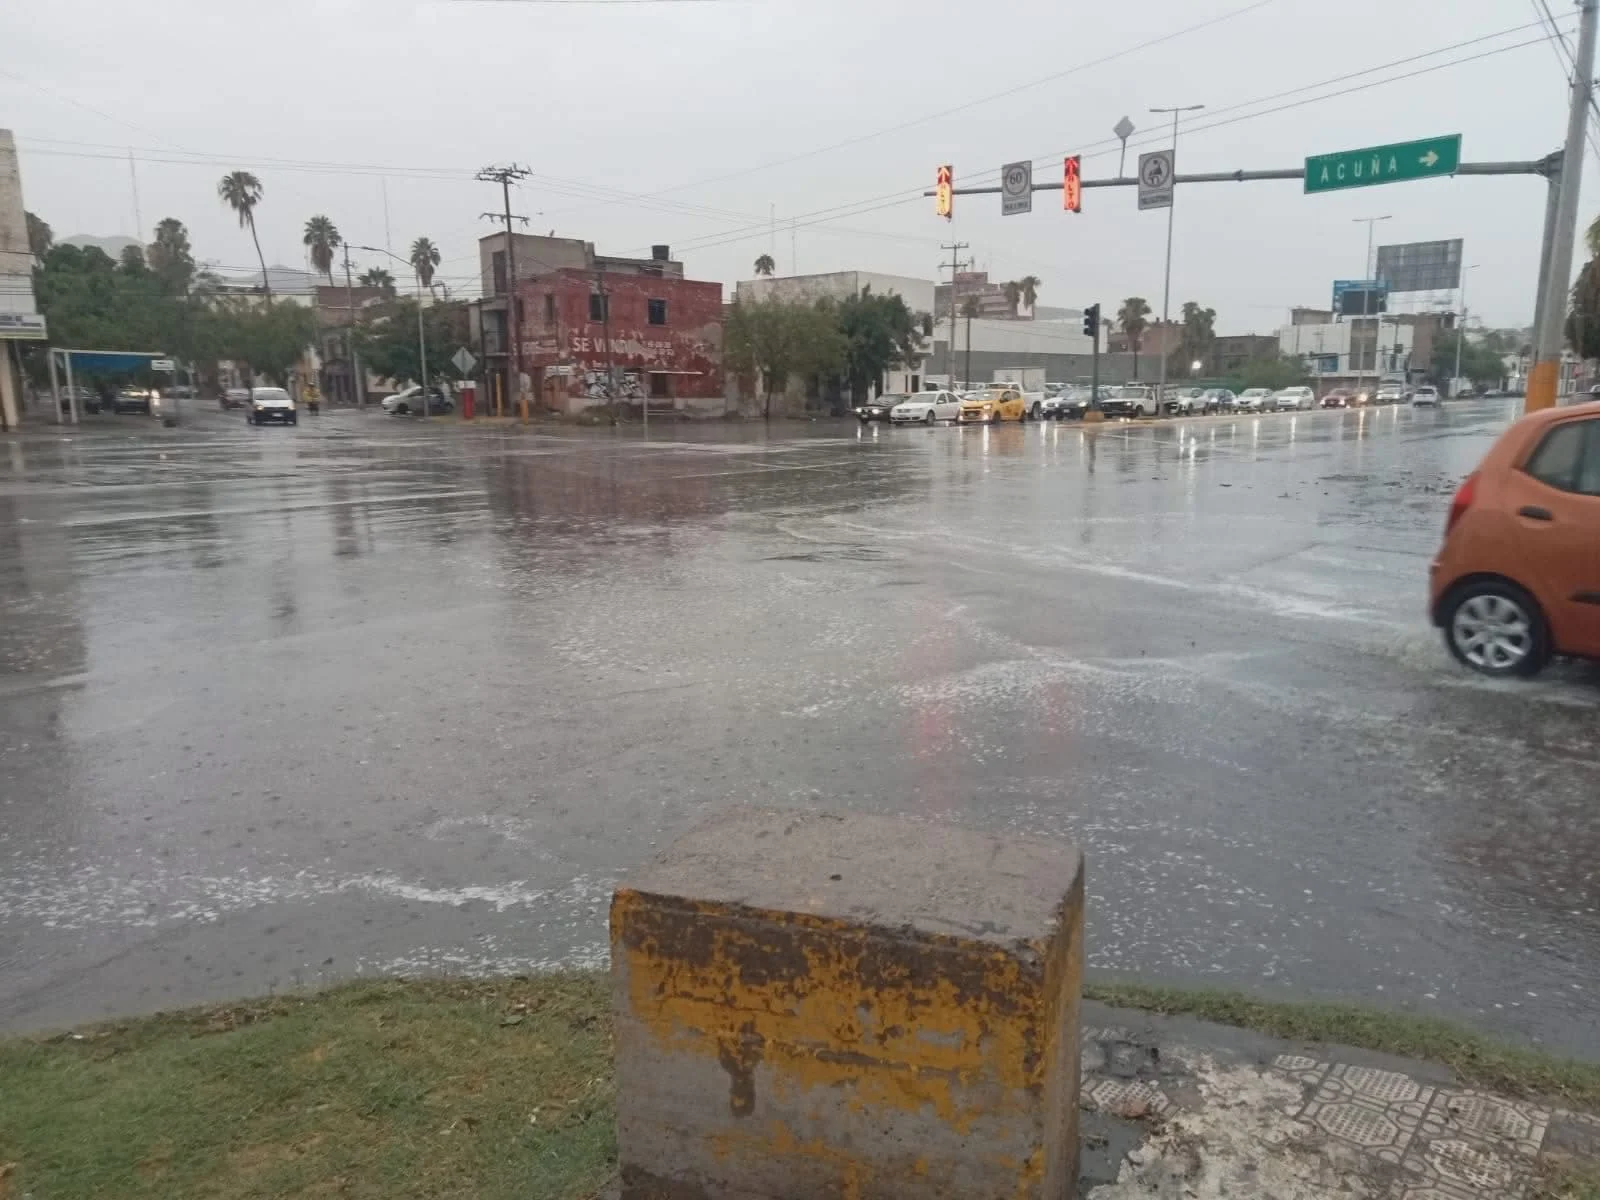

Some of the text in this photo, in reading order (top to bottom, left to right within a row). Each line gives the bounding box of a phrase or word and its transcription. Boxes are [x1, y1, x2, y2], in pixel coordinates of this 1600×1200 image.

[1009, 171, 1023, 185] 60
[1321, 154, 1397, 184] ACUÑA
[1067, 175, 1075, 210] ALTO
[573, 337, 590, 352] SE
